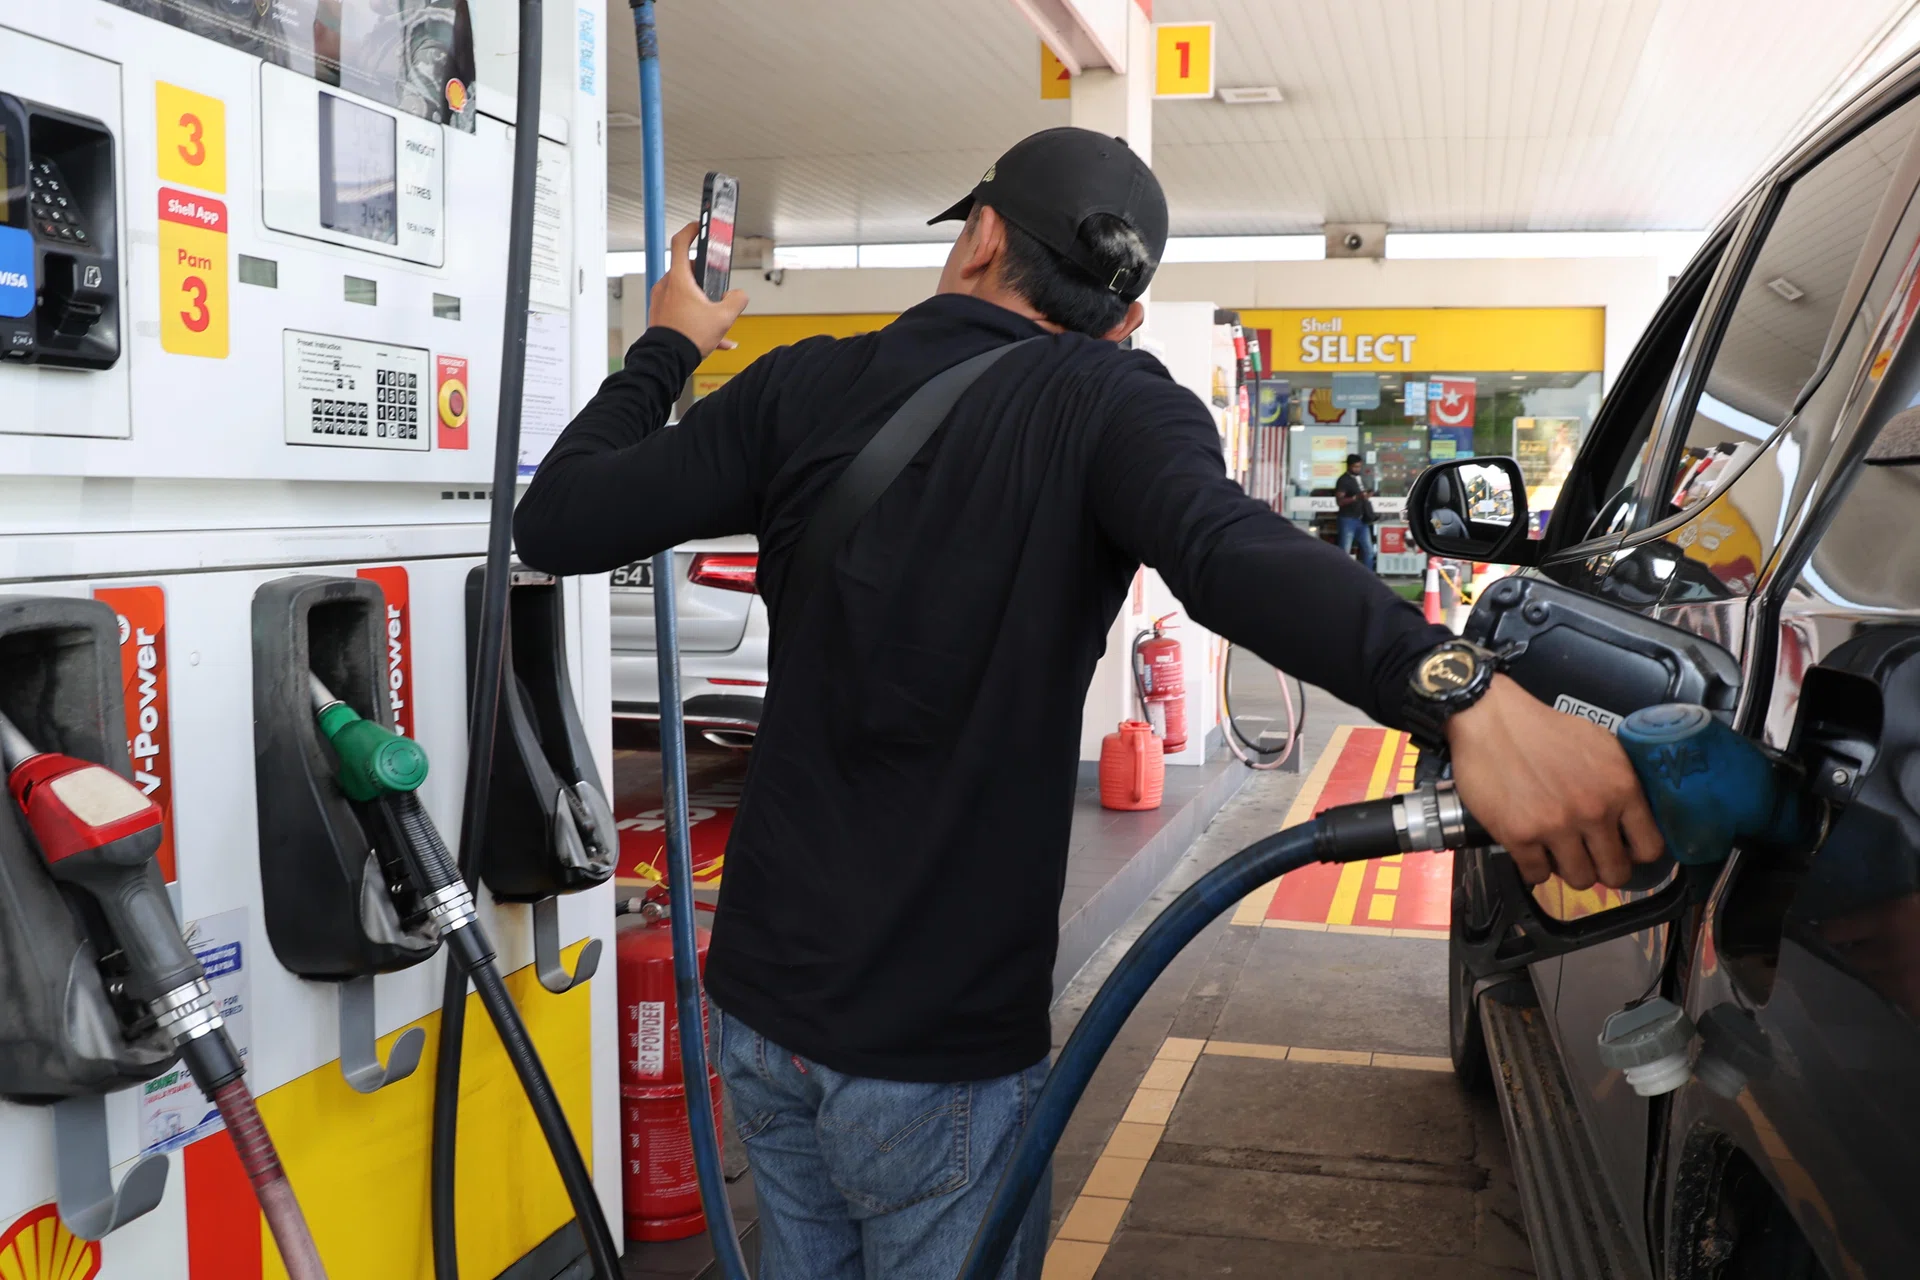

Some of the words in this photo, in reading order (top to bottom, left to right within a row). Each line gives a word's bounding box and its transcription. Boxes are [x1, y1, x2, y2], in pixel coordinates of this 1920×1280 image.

[1176, 42, 1190, 78] 1
[178, 112, 206, 167] 3
[168, 198, 196, 219] Shell
[196, 207, 219, 226] App
[177, 248, 212, 271] Pam
[180, 275, 210, 333] 3
[1301, 316, 1342, 333] Shell
[1300, 334, 1417, 364] SELECT
[378, 371, 385, 384] 7
[388, 372, 396, 385] 8
[378, 389, 385, 401] 4
[388, 390, 396, 402] 5
[399, 391, 405, 403] 6
[378, 406, 385, 419] 1
[388, 407, 396, 420] 2
[399, 408, 405, 421] 3
[378, 423, 385, 437] 0
[1311, 500, 1335, 508] PULL
[223, 995, 239, 1007] FOR
[641, 1003, 661, 1052] POWDER
